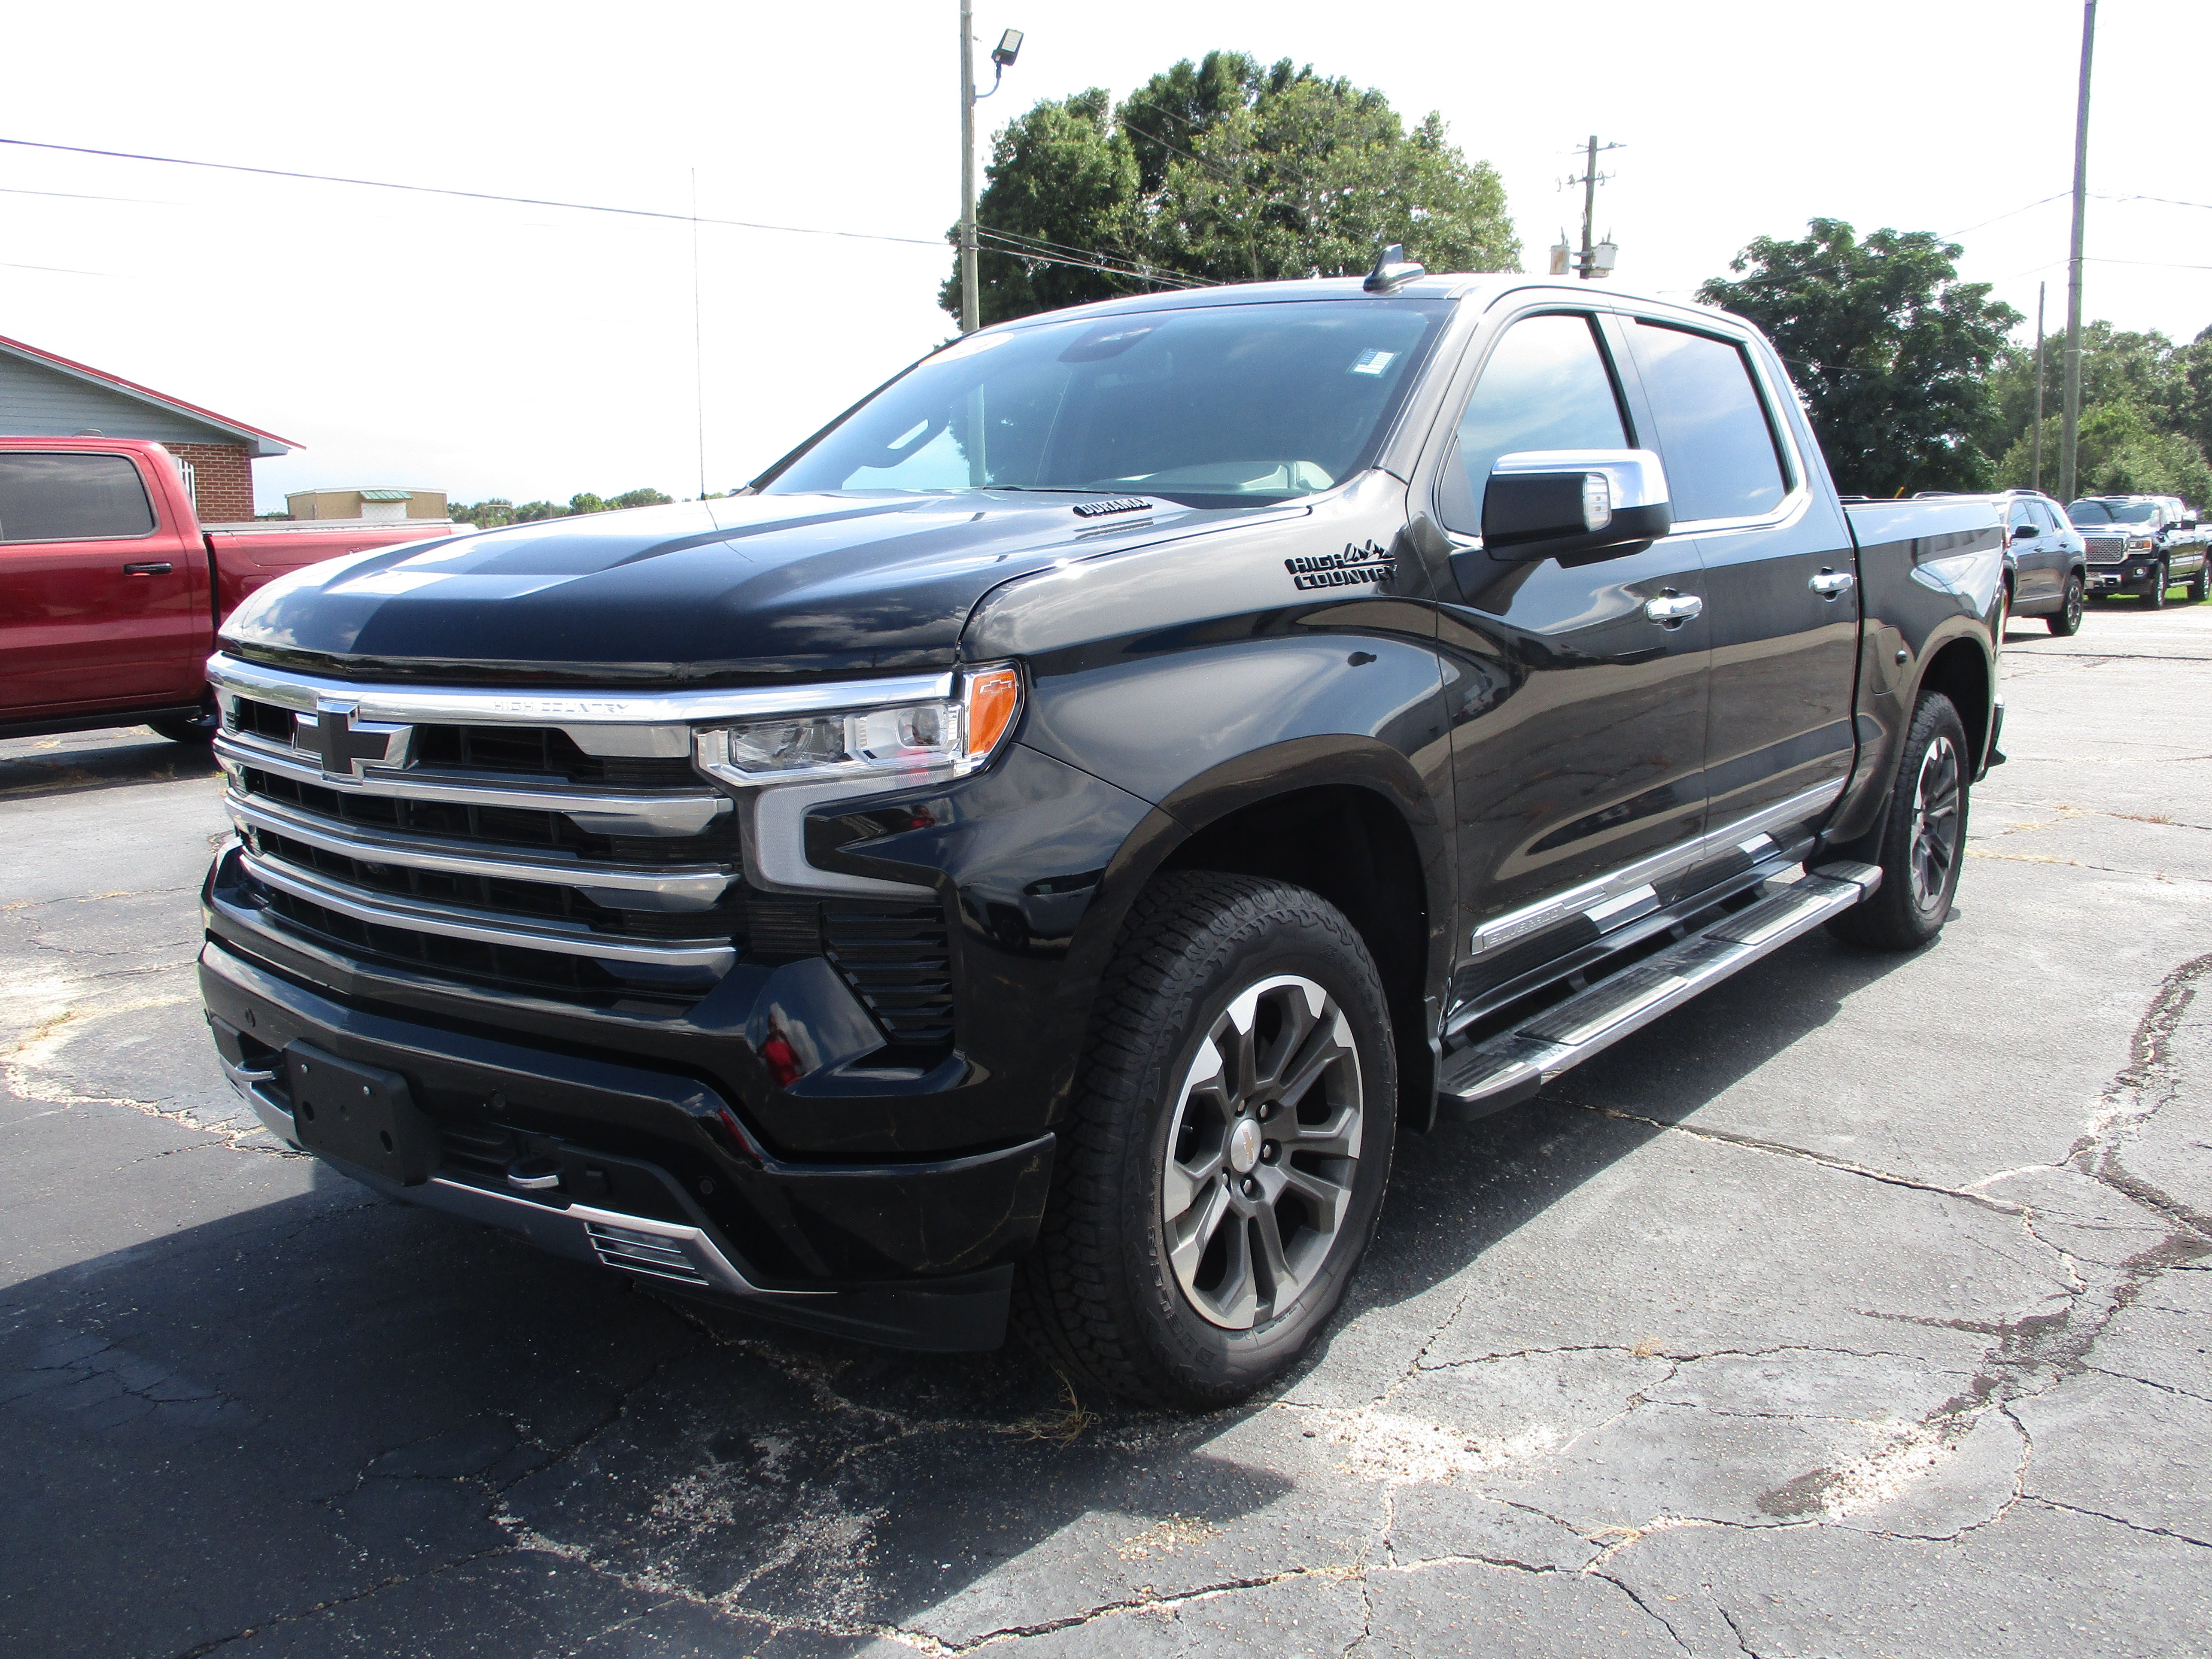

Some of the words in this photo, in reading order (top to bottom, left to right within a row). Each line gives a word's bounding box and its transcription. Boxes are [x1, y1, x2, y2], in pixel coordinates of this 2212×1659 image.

[1073, 497, 1153, 518] DURAMAX
[1284, 553, 1346, 574] HIGH
[1293, 564, 1398, 590] COUNTRY
[493, 702, 534, 711] HIGH
[541, 702, 629, 713] COUNTRY
[1489, 909, 1560, 945] SILVERADO
